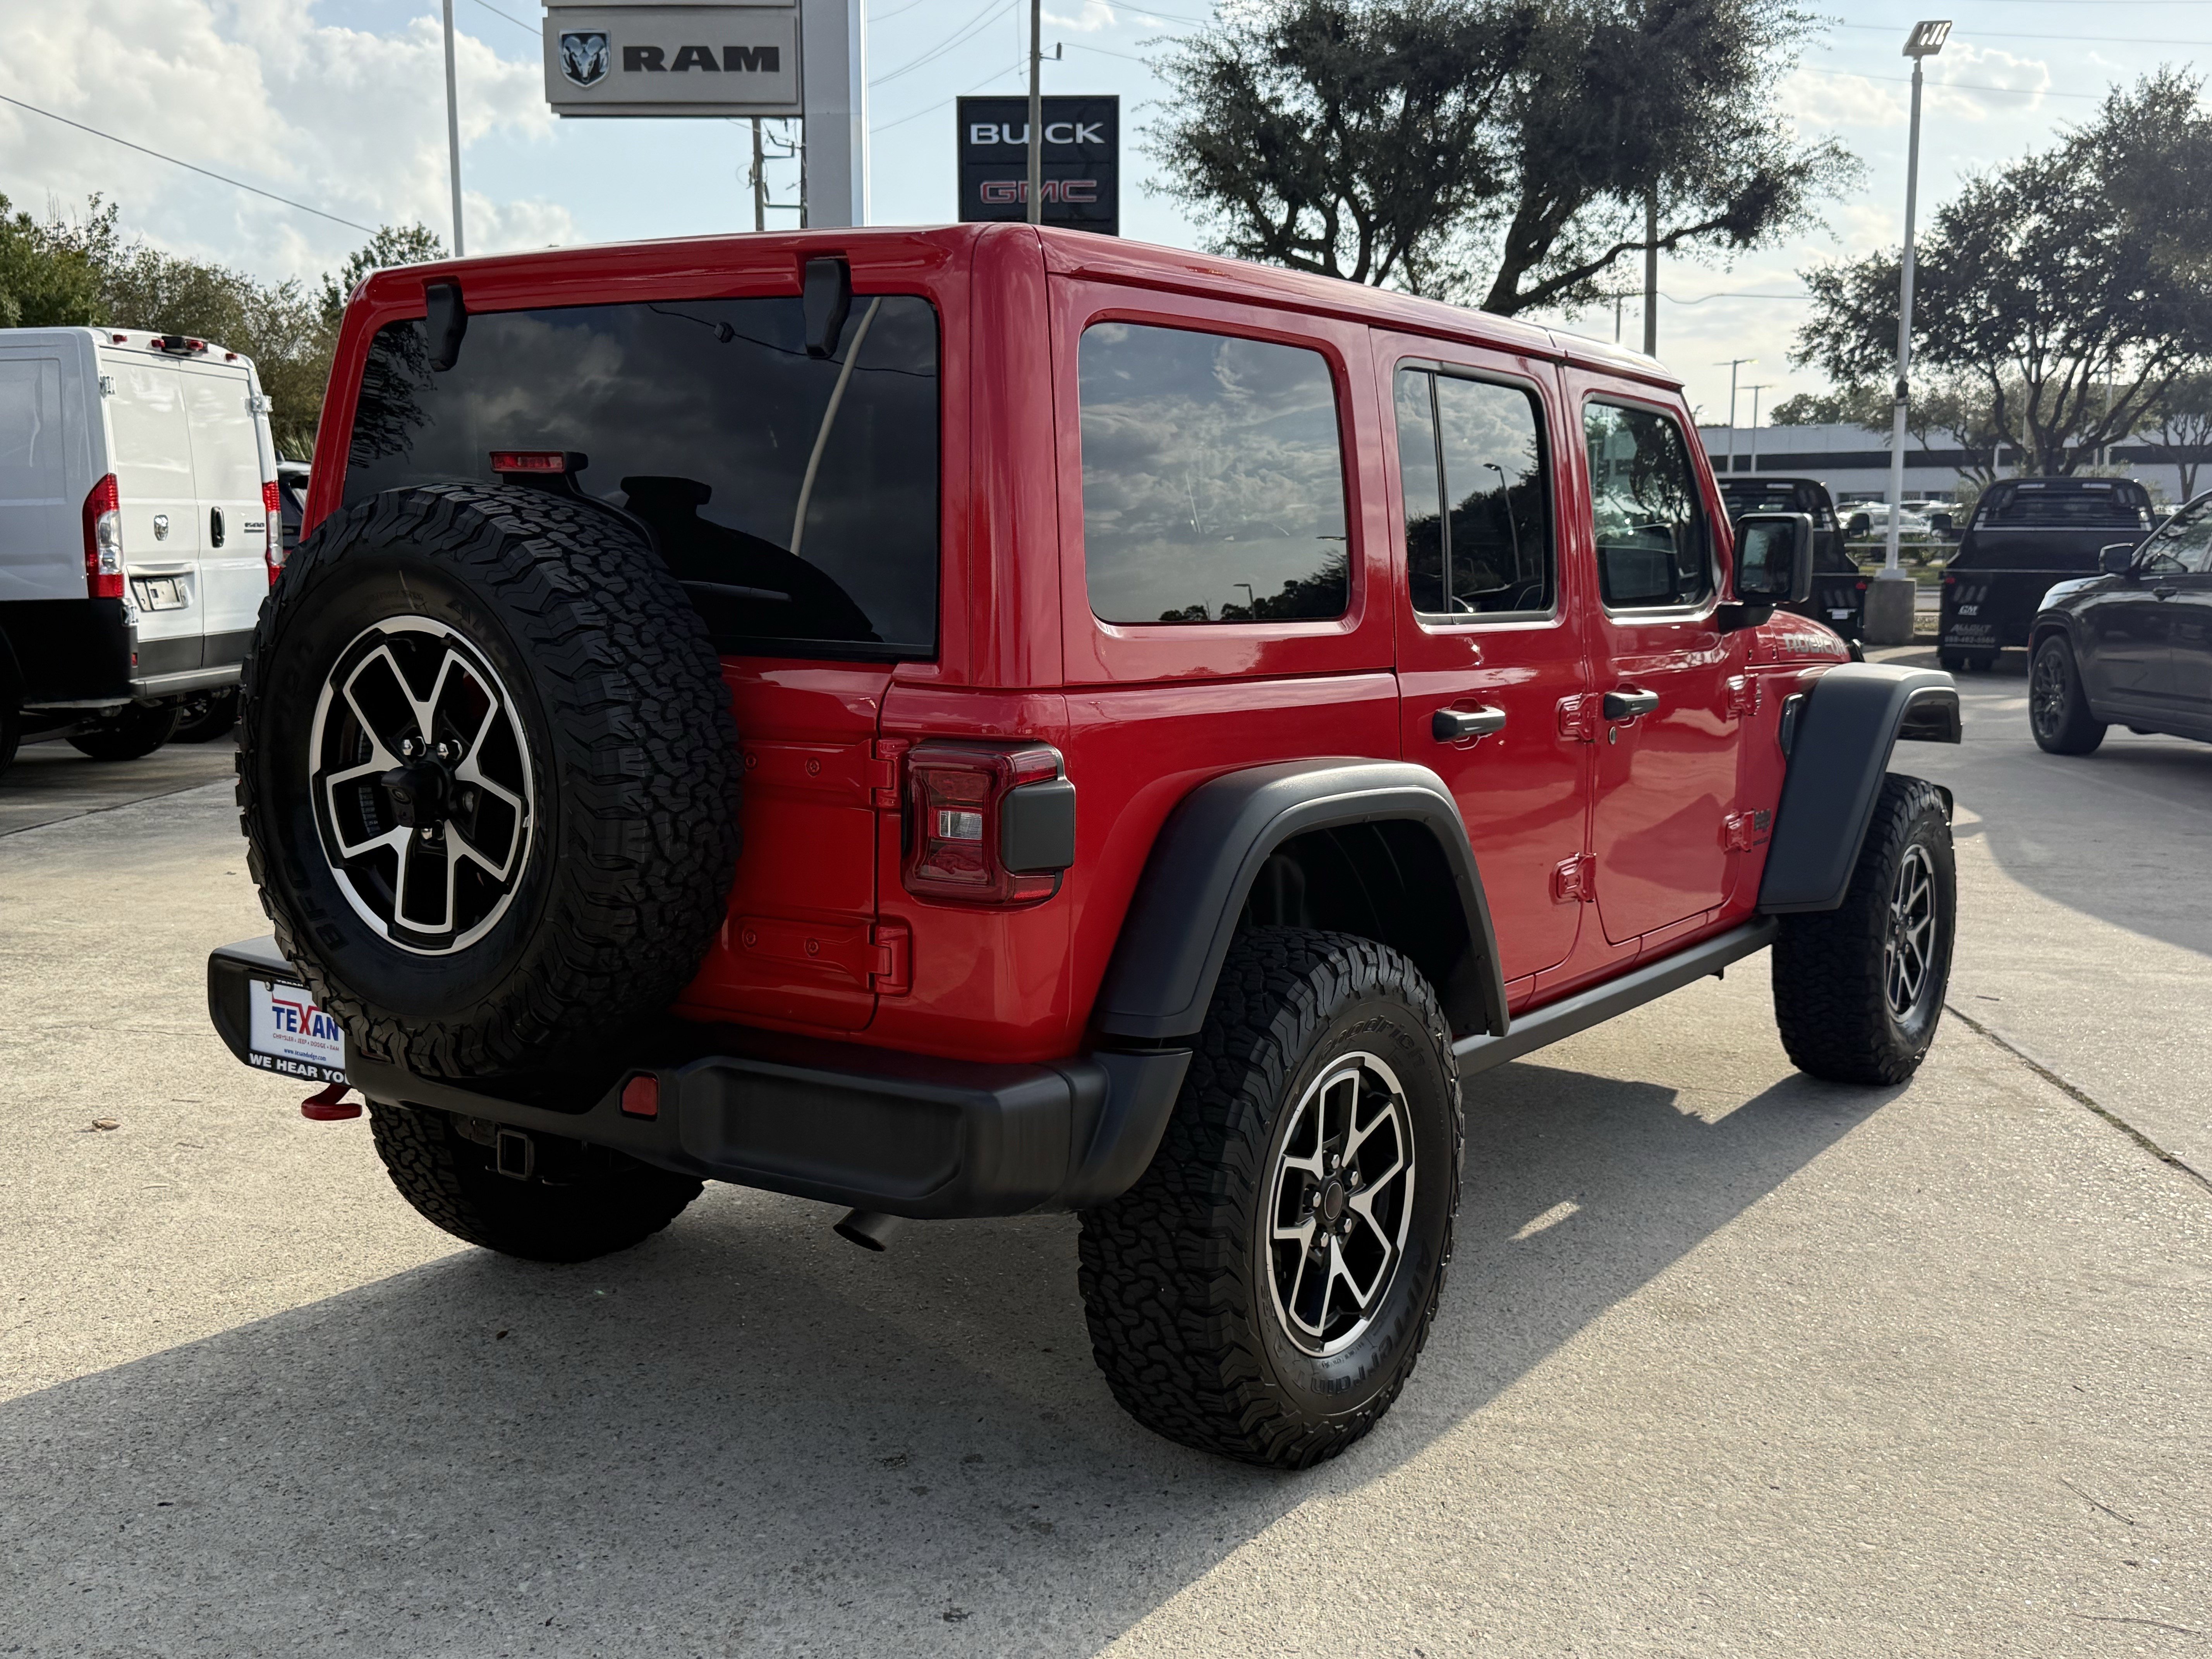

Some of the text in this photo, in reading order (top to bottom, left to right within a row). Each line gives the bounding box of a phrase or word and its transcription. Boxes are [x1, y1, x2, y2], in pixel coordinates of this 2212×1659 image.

[623, 46, 780, 72] RAM
[970, 122, 1105, 145] BUCK
[980, 180, 1097, 204] GMC
[272, 1003, 339, 1041] TEXAN
[273, 1032, 294, 1042] CHRYSLER
[310, 1041, 326, 1049] DODGE
[249, 1053, 272, 1068] WE
[276, 1059, 318, 1078] HEAR
